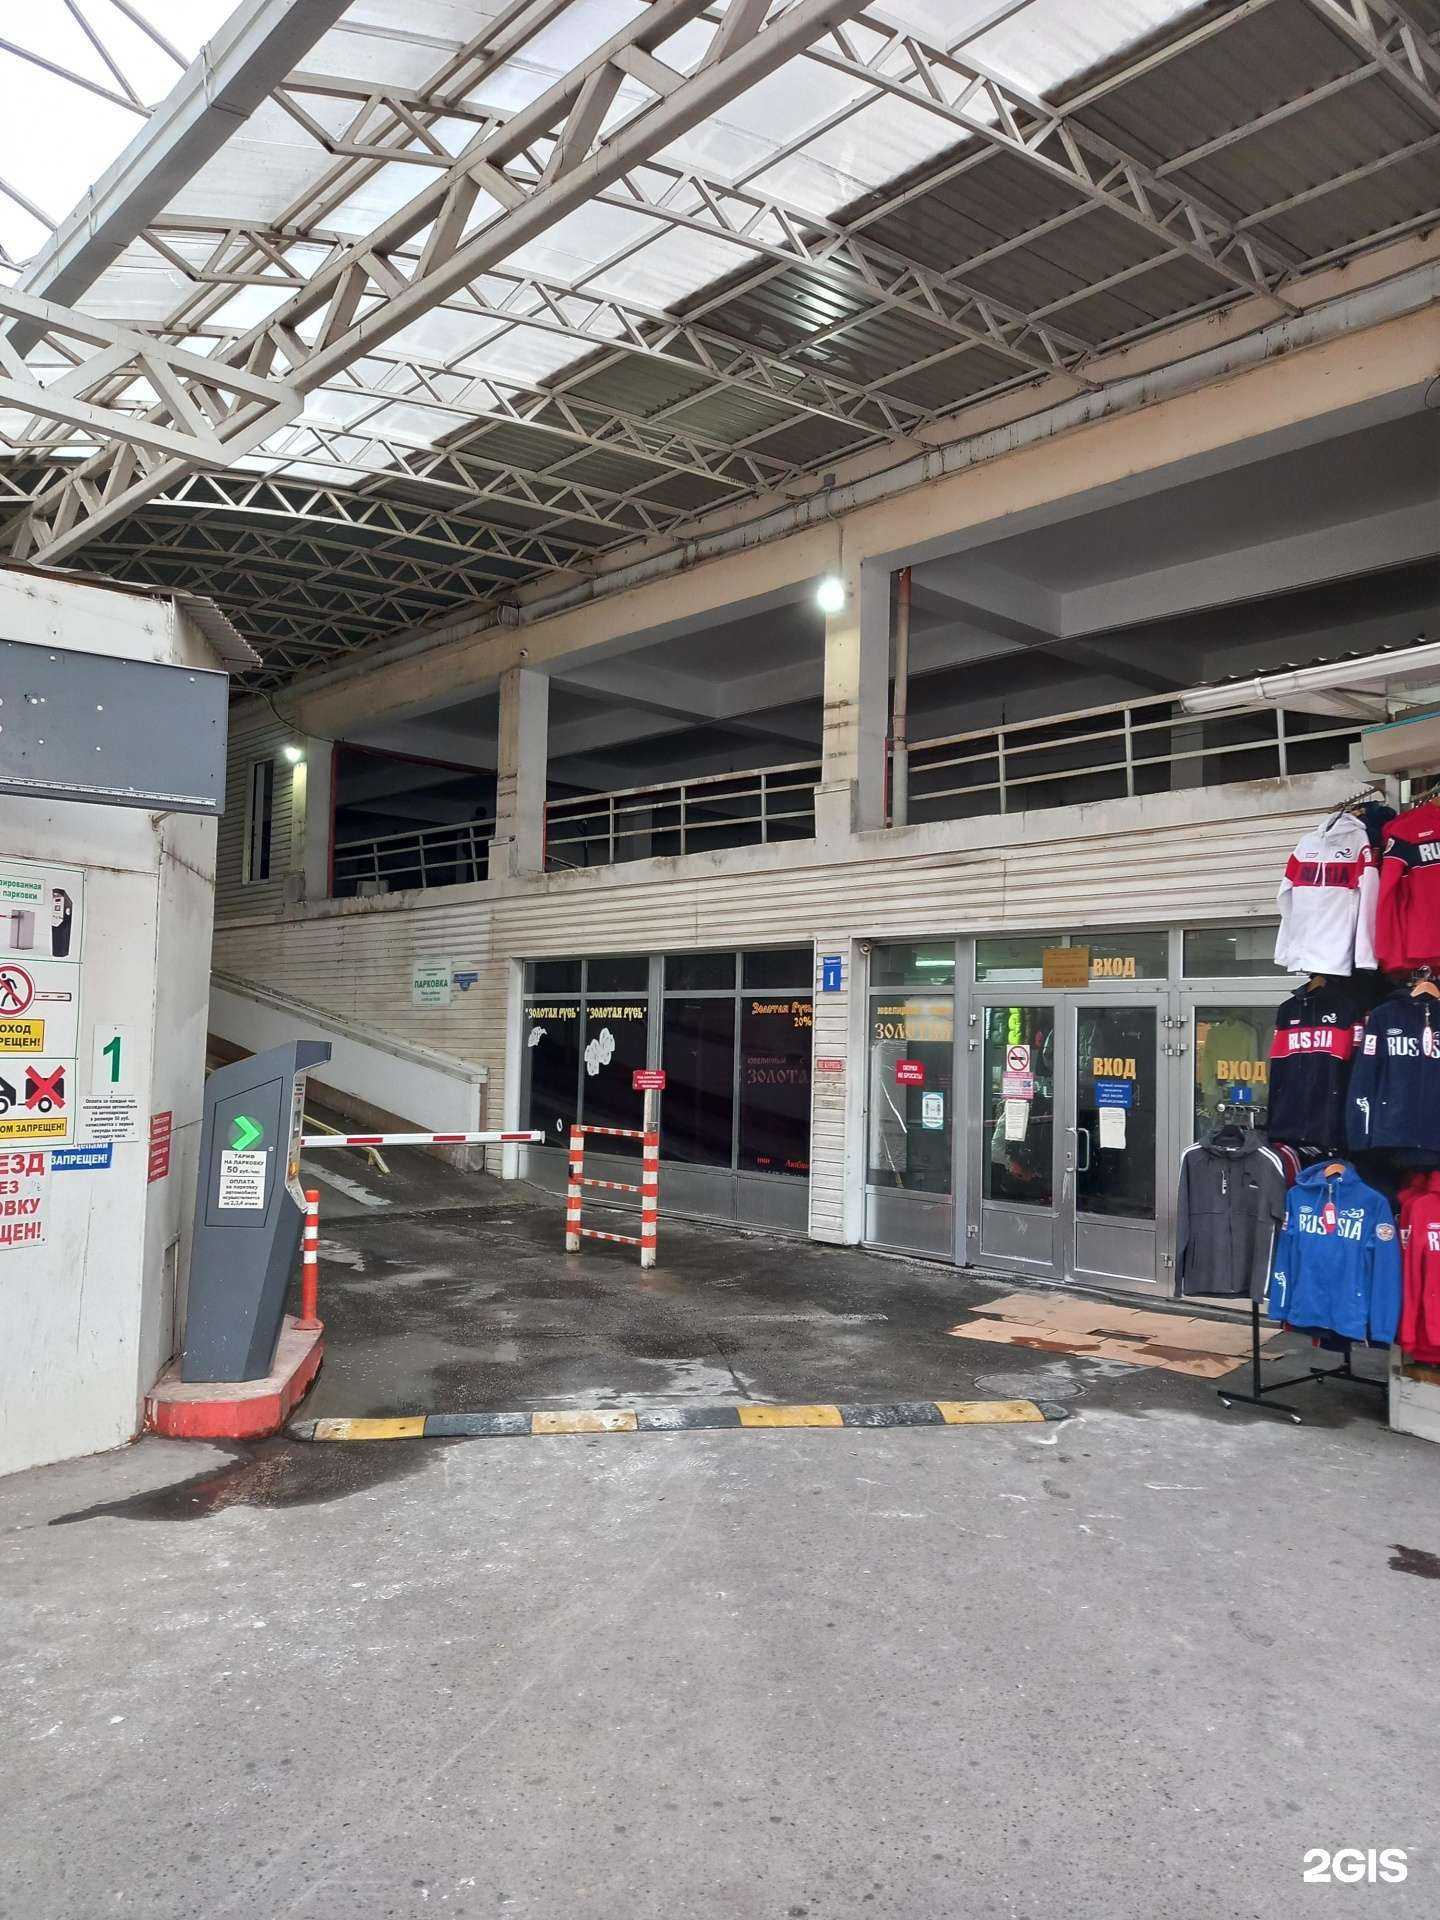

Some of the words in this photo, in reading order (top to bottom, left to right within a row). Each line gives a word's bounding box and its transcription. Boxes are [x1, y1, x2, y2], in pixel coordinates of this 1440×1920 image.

[2, 890, 37, 899] парковки
[1093, 957, 1136, 978] ВХОД
[415, 979, 448, 989] ПАРКОВКА
[828, 971, 835, 986] 1
[0, 1024, 31, 1035] ОХОД
[103, 1036, 121, 1082] 1
[1093, 1057, 1137, 1080] ВХОД
[1217, 1060, 1267, 1083] ВХОД
[15, 1123, 65, 1132] ЗАПРЕЩЕН!
[51, 1154, 108, 1165] ЗАПРЕЩЕН!
[0, 1198, 40, 1216] ВКУ
